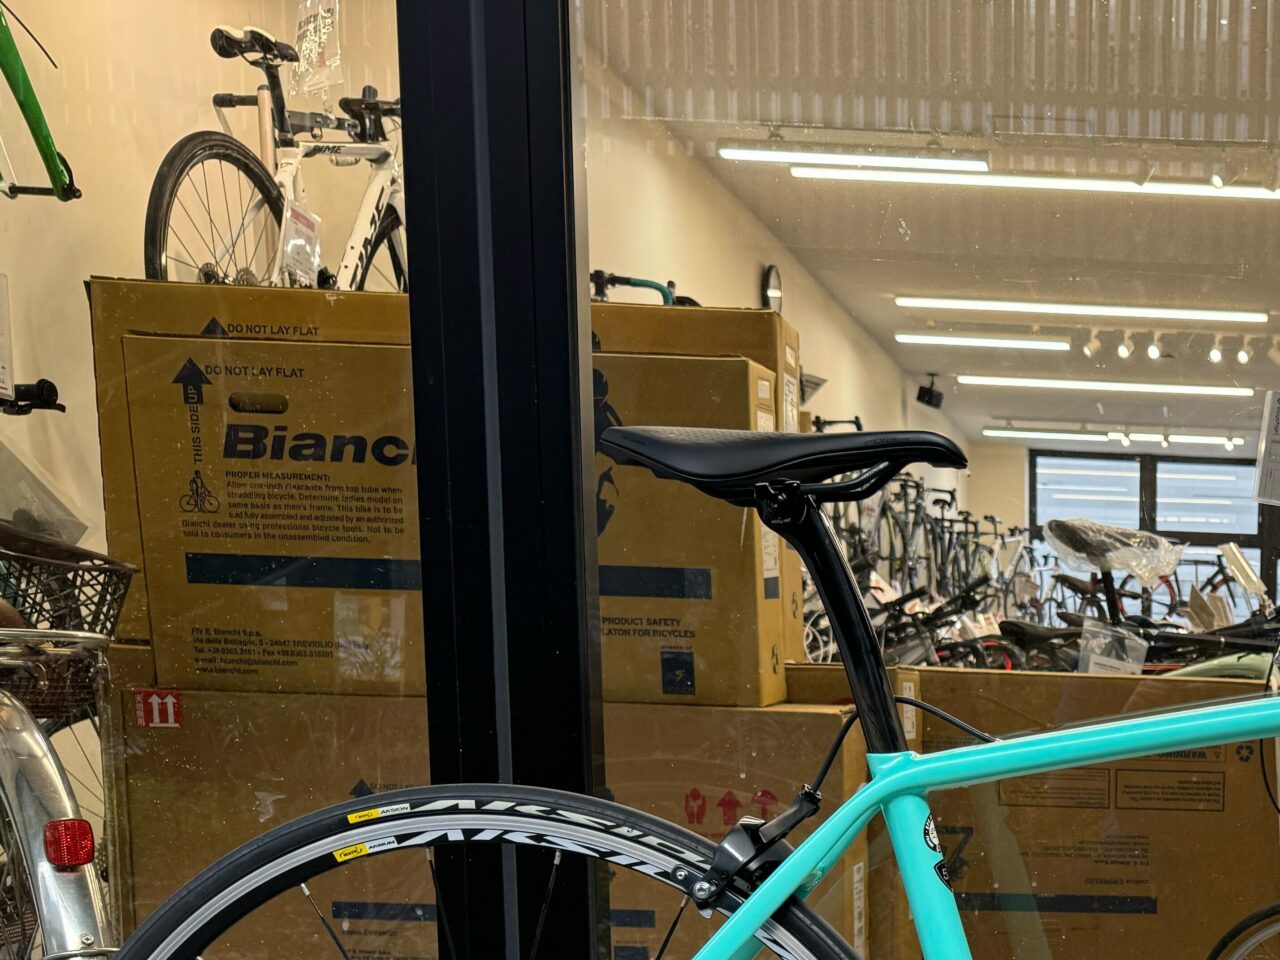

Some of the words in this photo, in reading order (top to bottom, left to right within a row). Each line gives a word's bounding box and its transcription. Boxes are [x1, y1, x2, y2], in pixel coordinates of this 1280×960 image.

[227, 323, 243, 333] DO
[246, 325, 268, 334] NOT
[270, 326, 292, 335] LAY
[293, 326, 319, 336] FLAT
[205, 365, 221, 376] DO
[224, 366, 248, 376] NOT
[276, 368, 304, 378] FLAT
[188, 385, 198, 403] UP
[190, 405, 201, 433] SIDE
[192, 434, 203, 464] THIS
[222, 424, 417, 466] Bianc
[225, 471, 260, 479] PROPER
[262, 472, 330, 482] MEASUREMENT:
[326, 484, 344, 492] from
[346, 485, 360, 493] top
[361, 485, 379, 493] tube
[227, 492, 265, 500] straddling
[267, 492, 296, 501] bicycle.
[367, 496, 391, 504] model
[392, 497, 403, 505] on
[250, 502, 270, 510] basis
[284, 503, 307, 511] men's
[337, 504, 353, 512] This
[355, 504, 372, 513] bike
[374, 505, 381, 513] is
[393, 506, 403, 514] be
[244, 512, 259, 520] fully
[260, 512, 298, 520] assembled
[299, 513, 312, 521] and
[313, 514, 344, 523] adjusted
[345, 515, 354, 524] by
[366, 515, 404, 524] authorized
[182, 519, 210, 527] Bianchi
[238, 522, 260, 530] usng
[262, 522, 309, 531] professional
[312, 524, 340, 533] bicycle
[342, 525, 365, 533] tools.
[367, 525, 381, 534] Not
[383, 526, 392, 534] to
[394, 526, 405, 534] be
[200, 530, 209, 538] to
[210, 531, 252, 539] consumers
[263, 532, 277, 540] the
[278, 533, 330, 542] unassembled
[331, 535, 371, 543] condition.
[602, 616, 643, 626] PRODUCT
[646, 617, 682, 627] SAFETY
[213, 627, 241, 636] Bianchi
[632, 629, 652, 637] FOR
[652, 629, 696, 639] BICYCLES
[292, 640, 334, 648] TREVIGLIO
[412, 799, 712, 868] AKSIO
